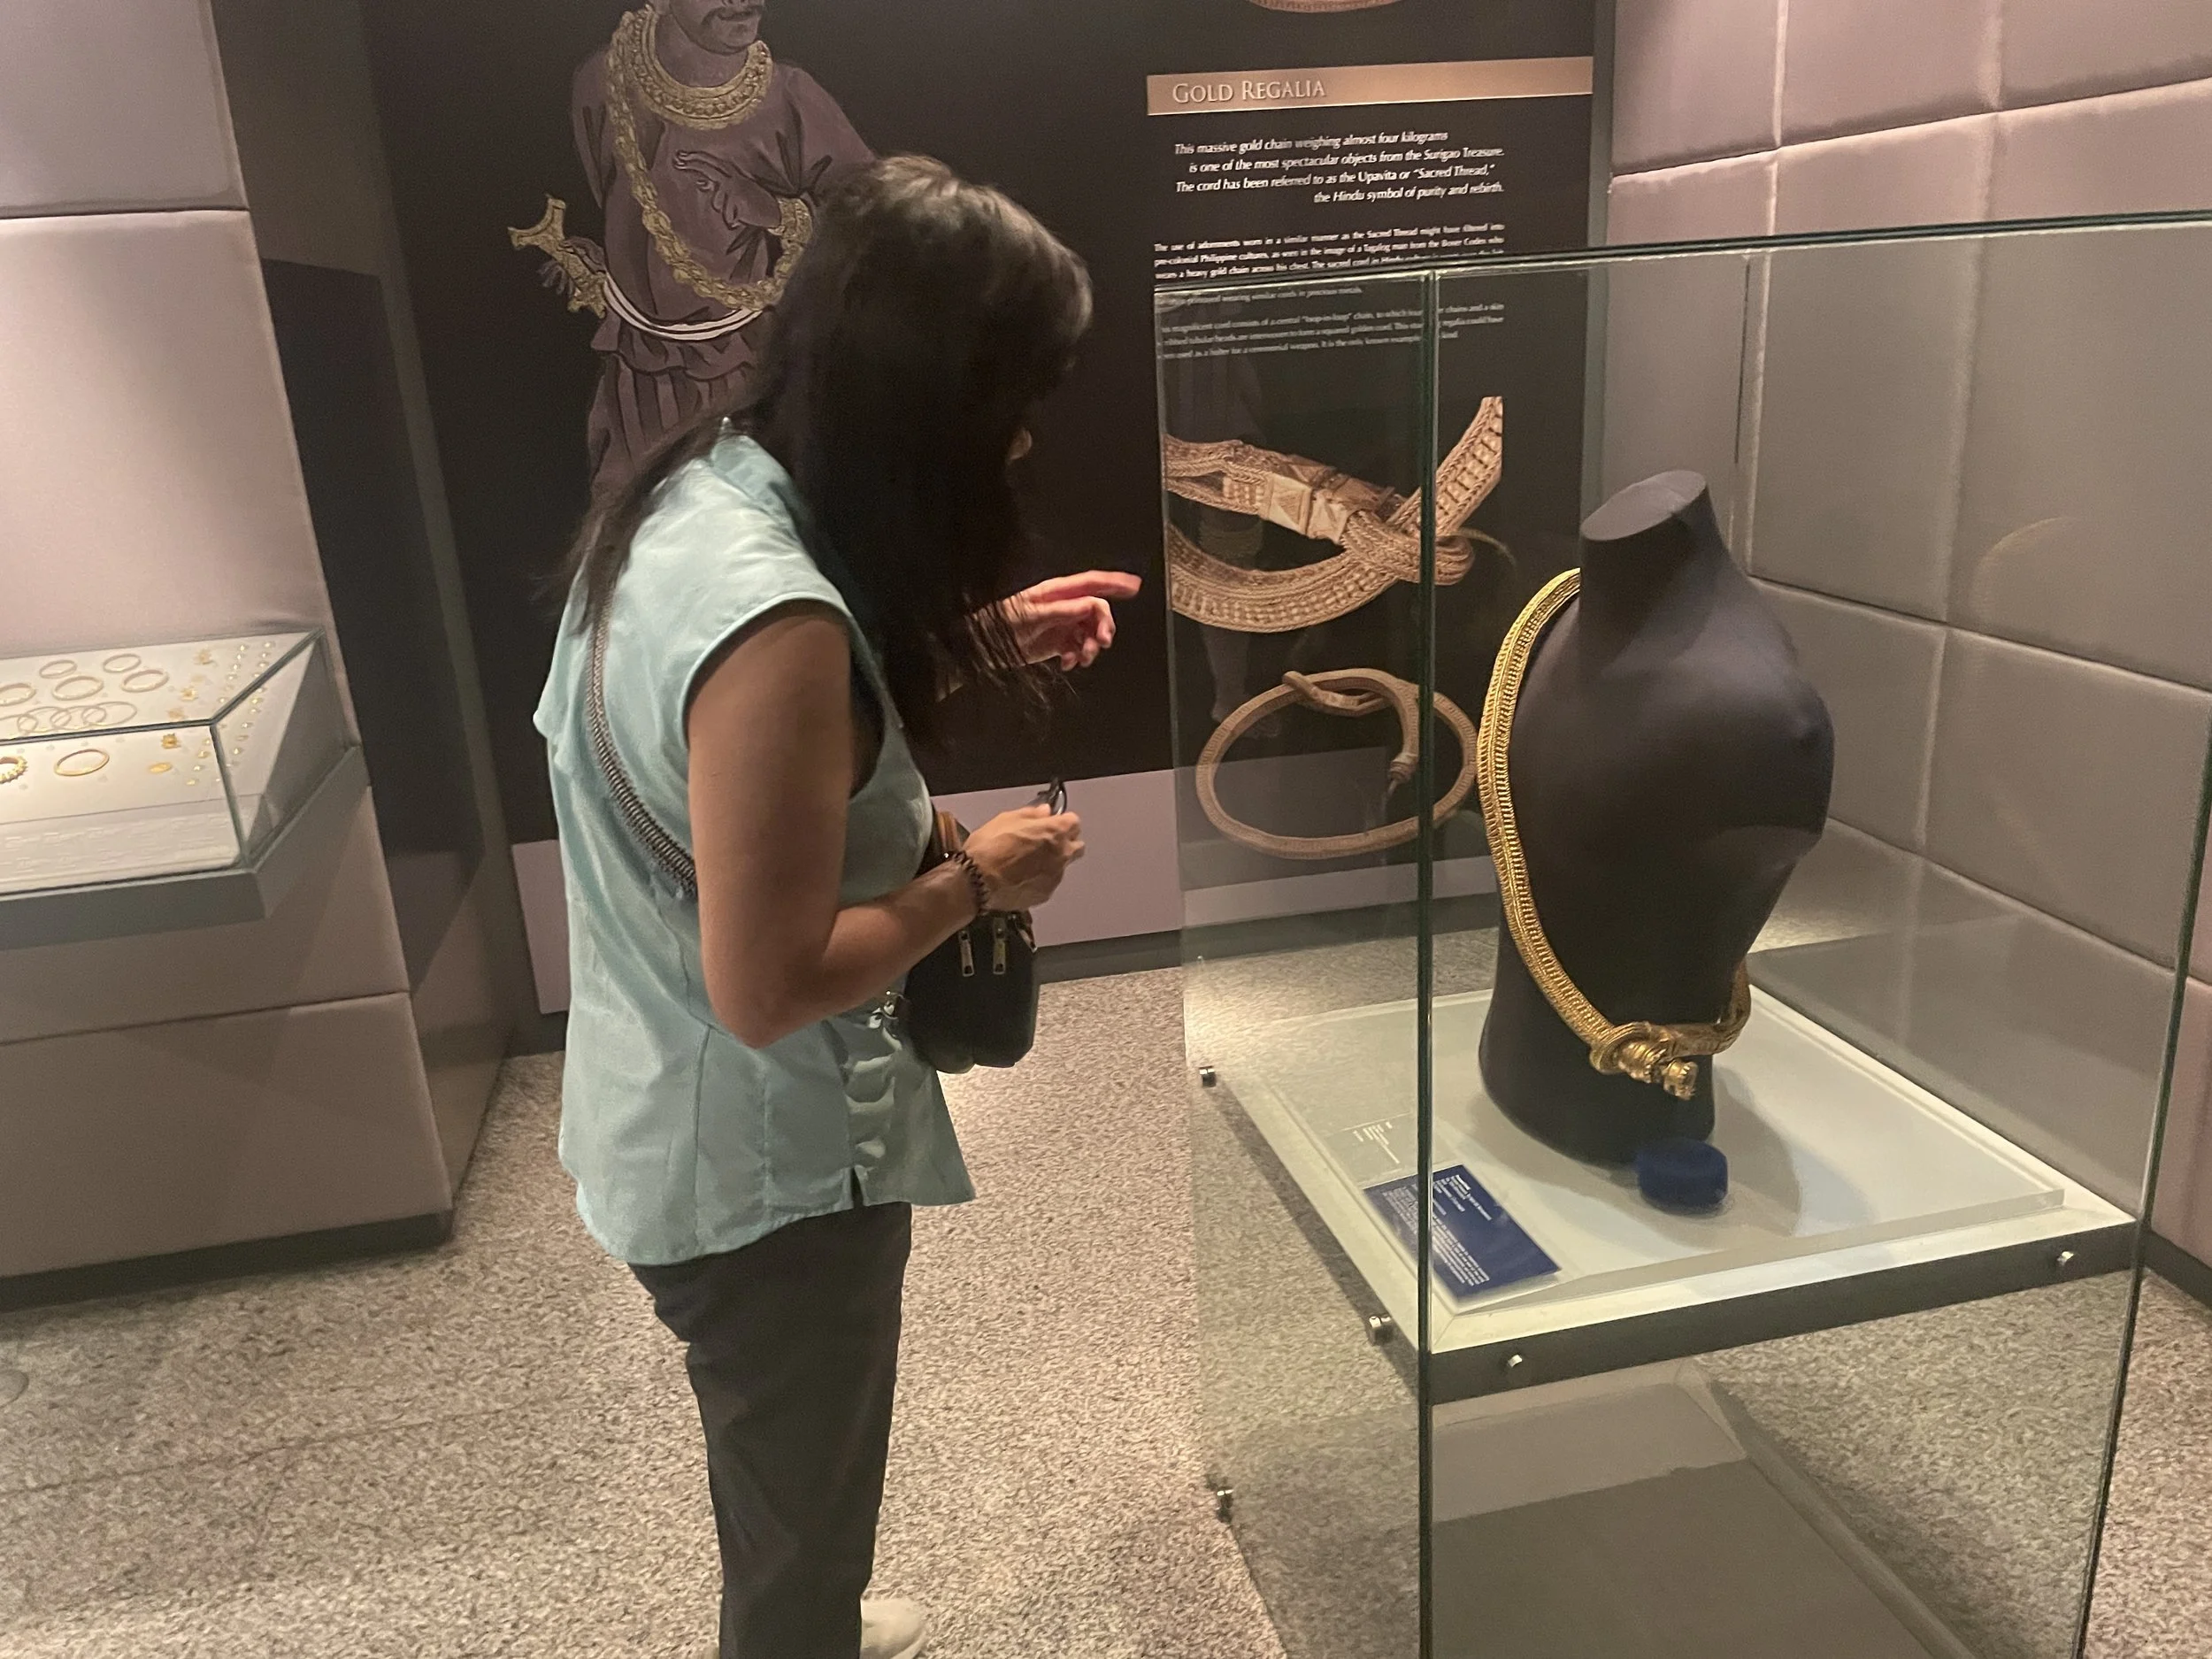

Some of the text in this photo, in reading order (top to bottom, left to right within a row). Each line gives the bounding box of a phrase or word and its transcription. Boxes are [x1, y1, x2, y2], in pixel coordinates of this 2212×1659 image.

[1172, 81, 1325, 103] GOLD REGALIA
[1175, 131, 1448, 154] This massive gold chain weighing almost four kilograms
[1189, 163, 1198, 173] is
[1222, 159, 1234, 171] of
[1235, 159, 1252, 170] the
[1254, 159, 1279, 169] most
[1281, 154, 1339, 170] spectacular
[1340, 153, 1377, 166] objects
[1379, 150, 1402, 162] from
[1405, 150, 1422, 161] the
[1424, 149, 1460, 162] Surigao
[1463, 147, 1504, 157] Treasure.
[1176, 181, 1194, 192] The
[1196, 179, 1221, 191] cord
[1223, 179, 1240, 189] has
[1243, 177, 1268, 188] been
[1271, 173, 1311, 187] referred
[1313, 175, 1324, 185] to
[1325, 174, 1337, 183] as
[1339, 172, 1356, 183] the
[1358, 169, 1397, 184] Upavita
[1399, 171, 1410, 180] or
[1313, 181, 1504, 204] the Hindu symbol of purity and rebirth.
